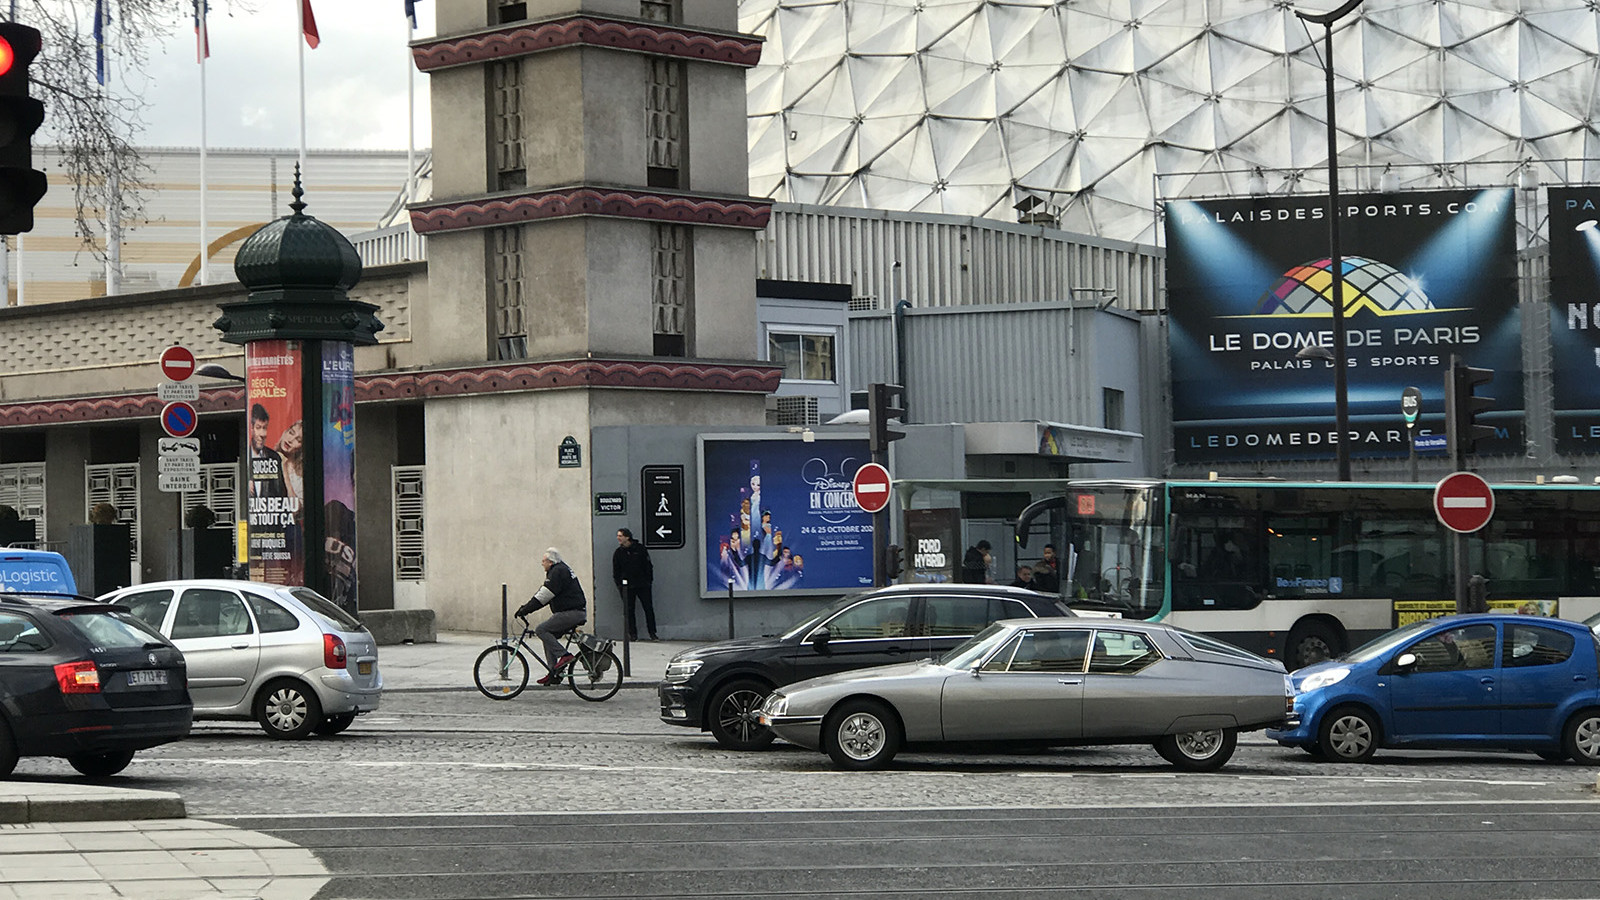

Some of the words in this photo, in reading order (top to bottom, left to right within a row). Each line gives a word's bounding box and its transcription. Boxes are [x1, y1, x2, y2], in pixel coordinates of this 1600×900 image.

[1181, 201, 1500, 225] PALAISDESPORTS.COM
[1209, 333, 1241, 352] LE
[1253, 330, 1335, 350] DOME
[1346, 329, 1382, 347] DE
[1394, 326, 1481, 345] PARIS
[1250, 359, 1312, 370] PALAIS
[1325, 357, 1358, 369] DS
[1371, 355, 1440, 367] SPORTS
[251, 377, 274, 388] RÉGIS
[1403, 396, 1417, 407] BUS
[253, 458, 278, 474] SUCCÈS
[267, 497, 298, 512] BEAU
[810, 492, 821, 509] EN
[824, 491, 858, 508] CONCER
[280, 512, 295, 528] ÇA
[801, 526, 810, 534] 24
[827, 525, 859, 533] OCTOBRE
[860, 525, 874, 533] 202
[918, 538, 941, 553] FORD
[914, 553, 946, 568] HYBRID
